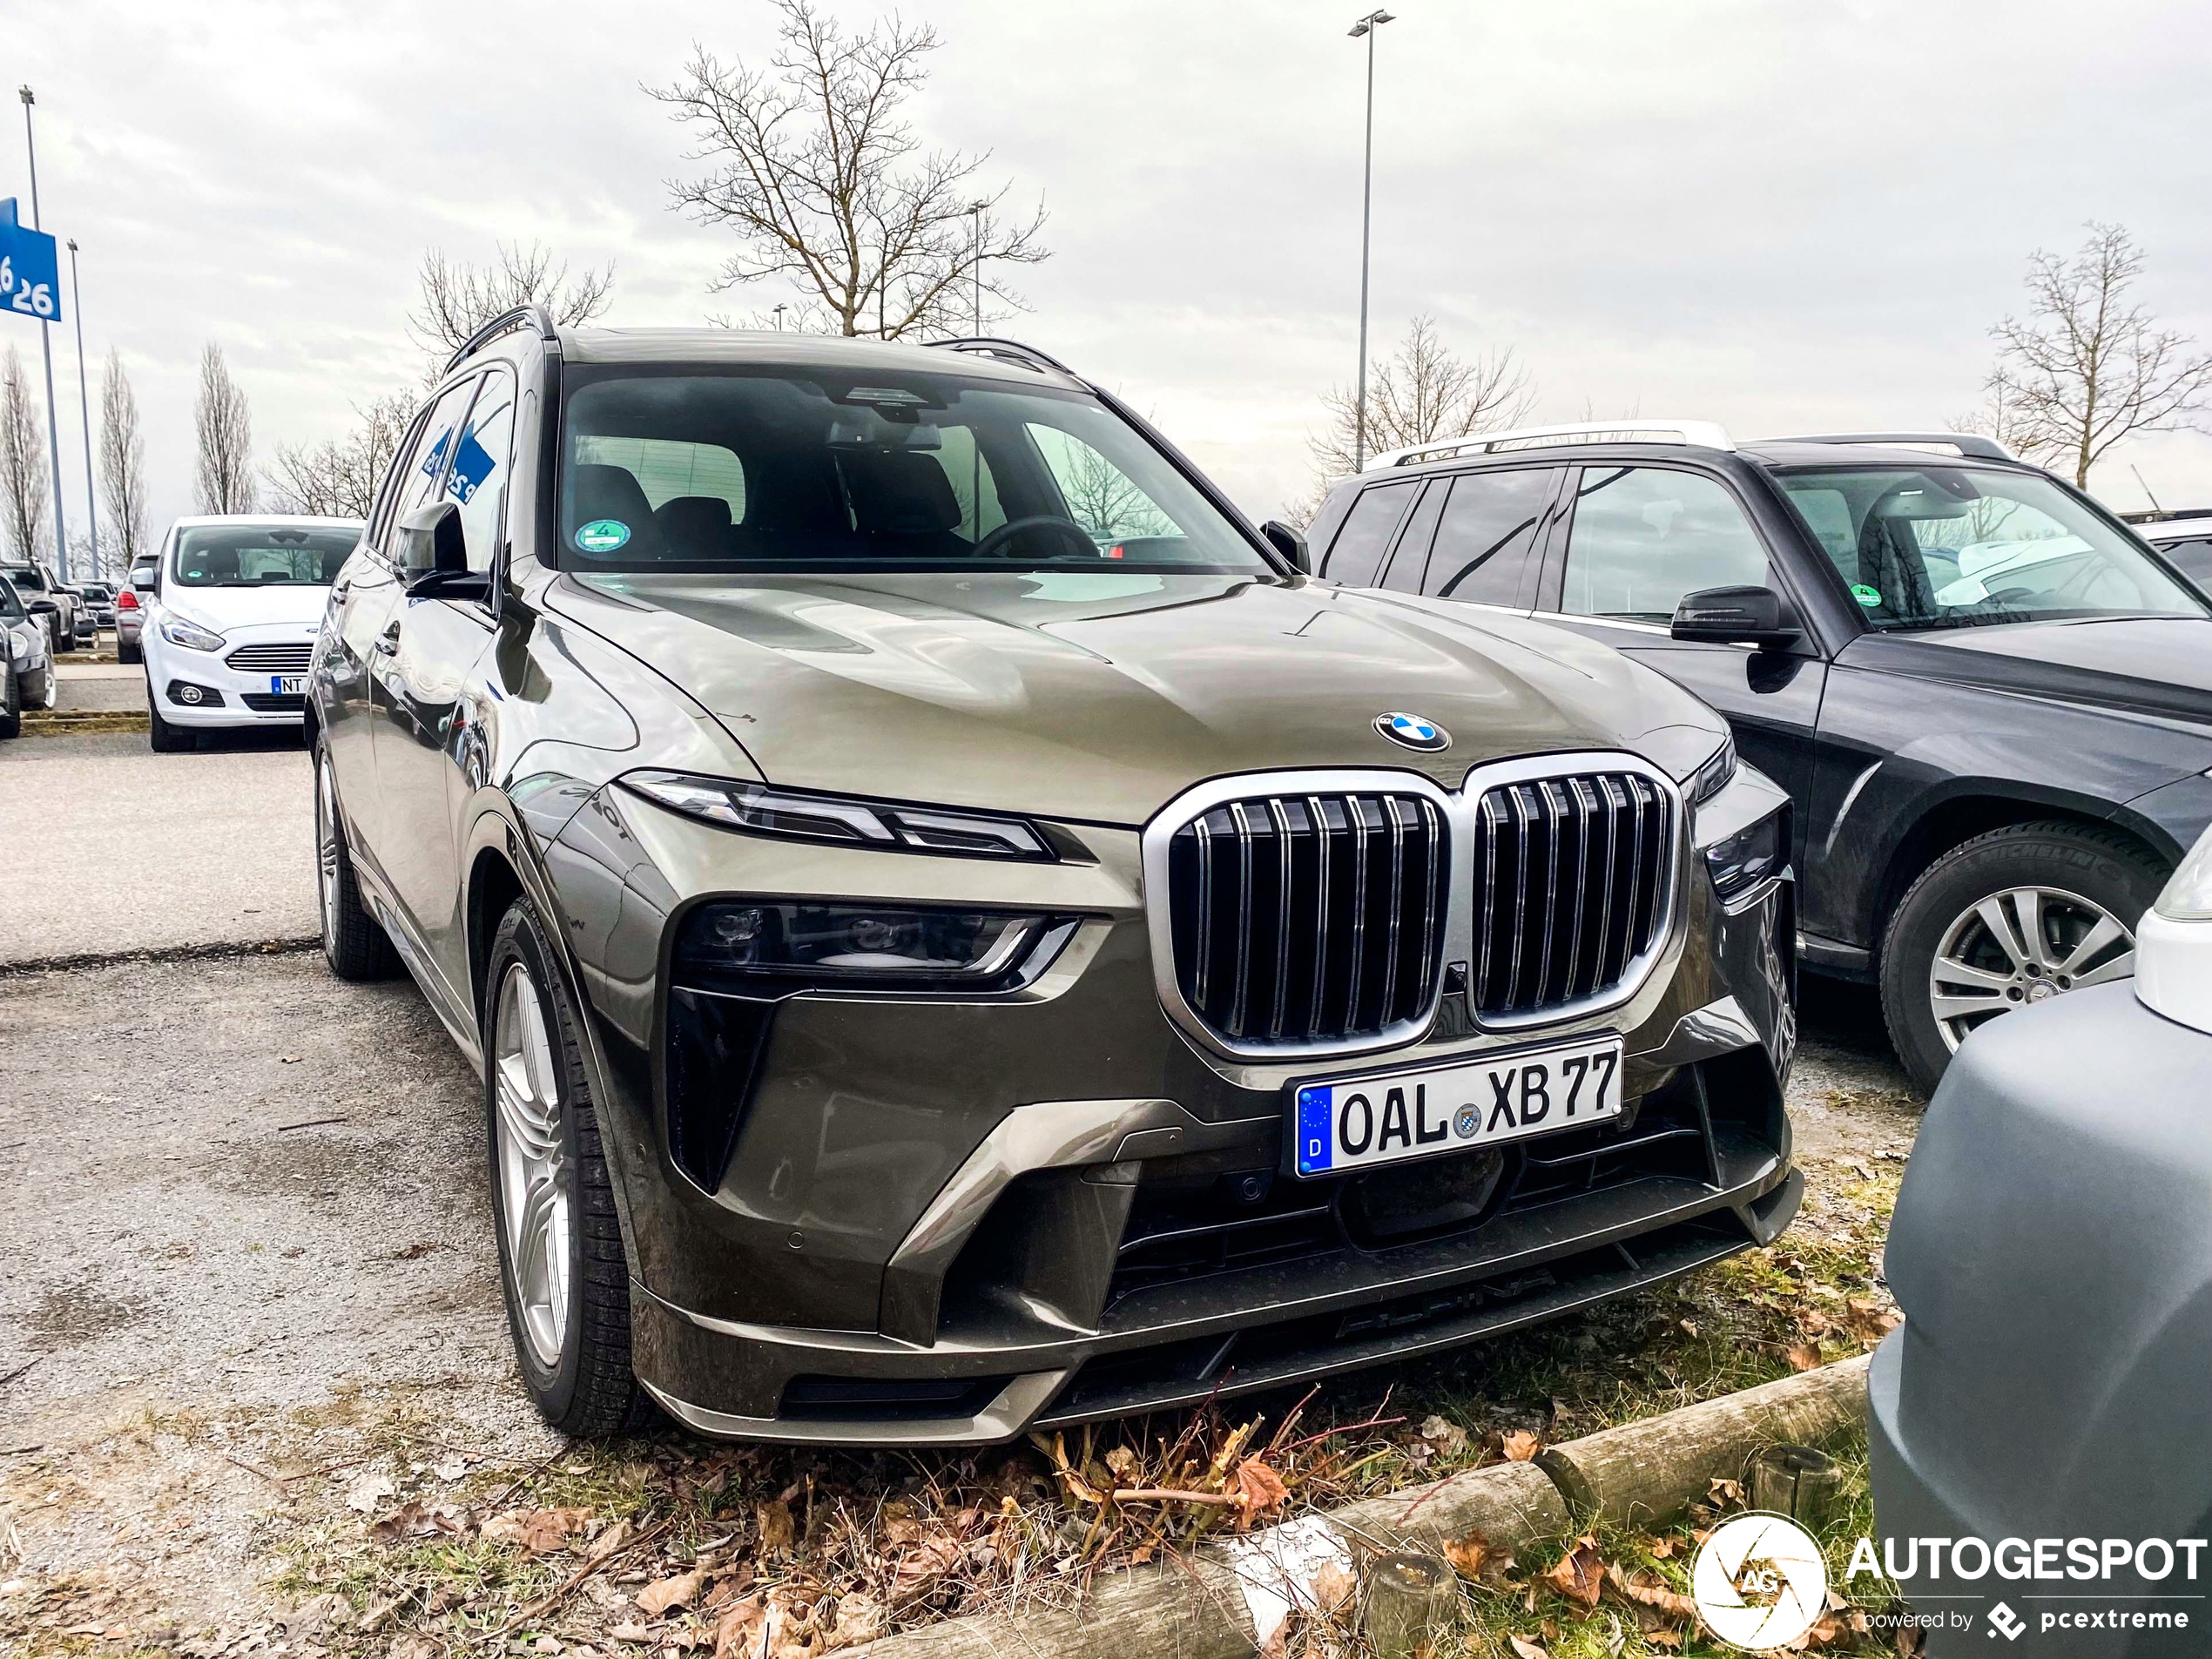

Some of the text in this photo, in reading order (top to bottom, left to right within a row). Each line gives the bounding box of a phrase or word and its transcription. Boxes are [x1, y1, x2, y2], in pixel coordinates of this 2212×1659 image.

[12, 278, 54, 315] 26
[596, 523, 610, 536] 4
[282, 678, 302, 692] NT
[1979, 844, 2095, 869] MICHELIN
[1339, 1082, 1448, 1156] OAL
[1486, 1063, 1550, 1133] XB
[1562, 1050, 1618, 1116] 77
[1309, 1138, 1321, 1157] D
